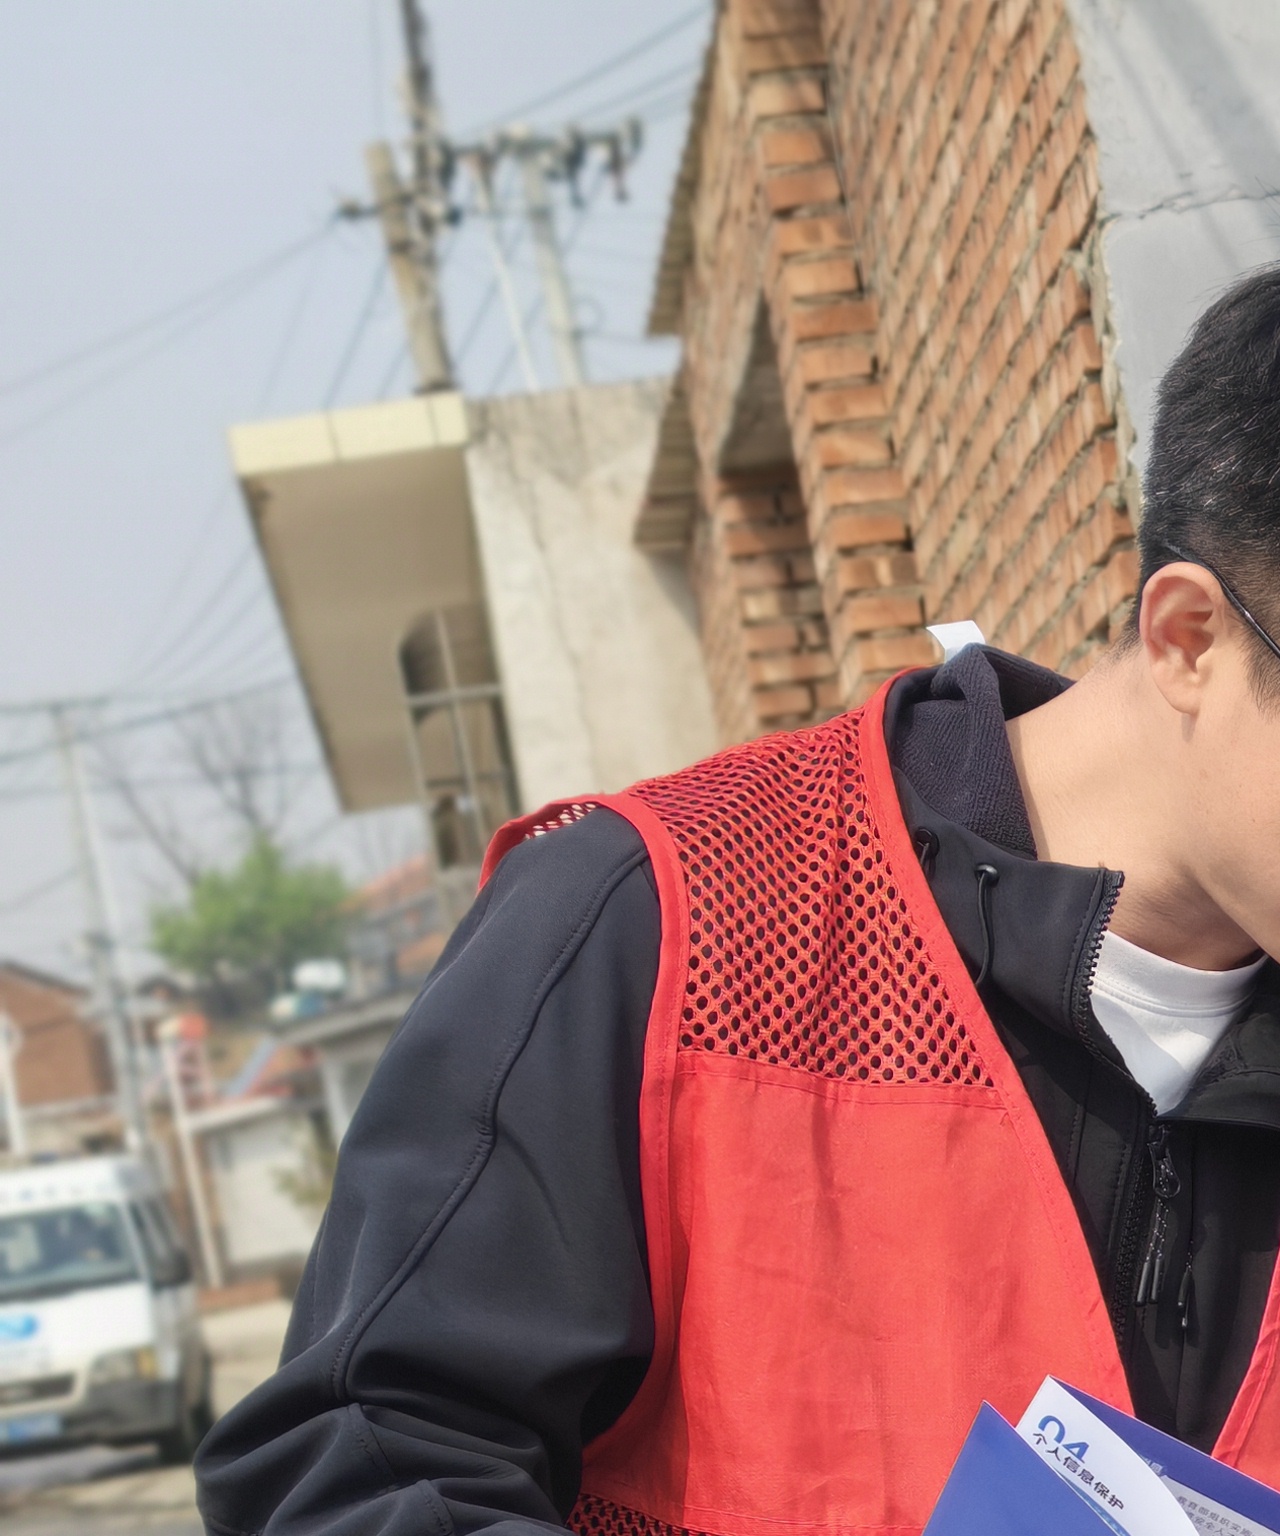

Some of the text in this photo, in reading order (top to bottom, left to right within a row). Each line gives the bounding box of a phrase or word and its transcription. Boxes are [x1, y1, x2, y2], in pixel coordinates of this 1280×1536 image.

[1033, 1432, 1124, 1511] 个人信息保护
